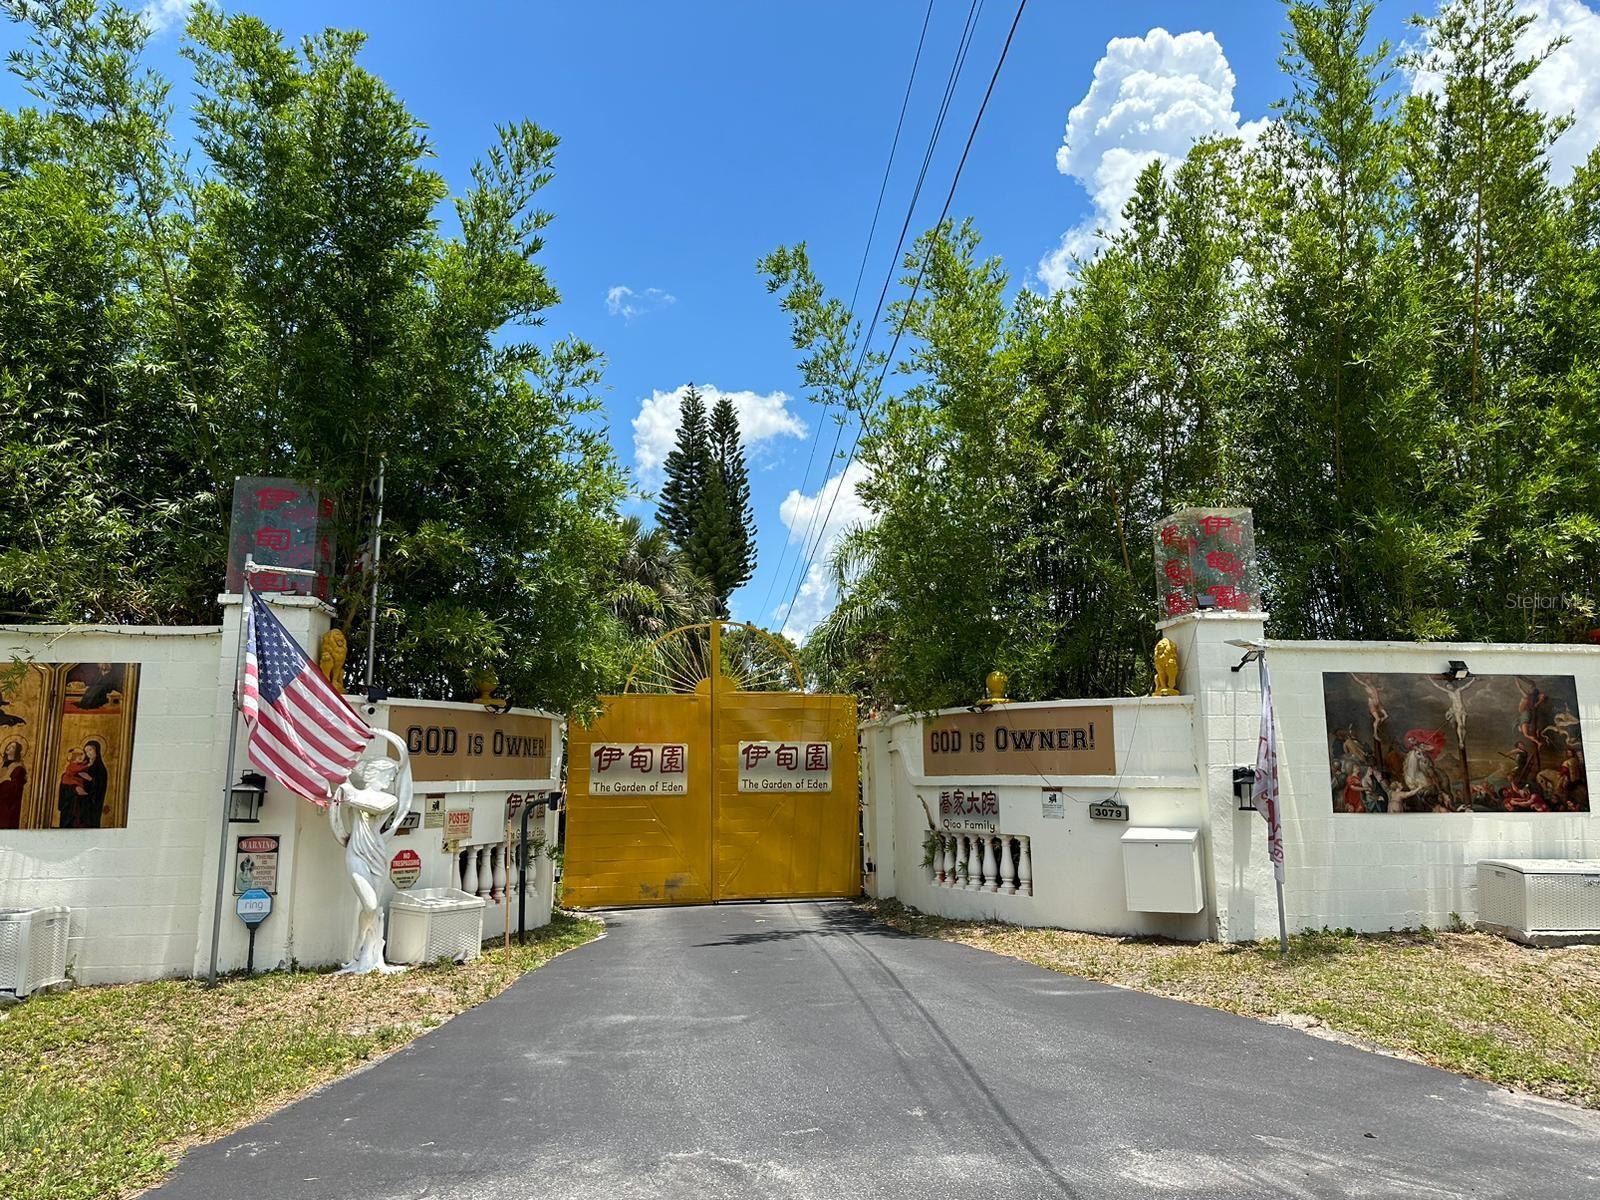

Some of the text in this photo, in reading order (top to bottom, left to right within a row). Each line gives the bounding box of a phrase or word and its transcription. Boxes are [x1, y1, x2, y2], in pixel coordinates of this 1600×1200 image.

[406, 725, 458, 755] GOD
[930, 729, 962, 754] GOD
[593, 745, 684, 773] 伊甸園
[741, 743, 829, 771] 伊甸園
[593, 781, 684, 792] The Garden of Eden
[742, 778, 828, 789] The Garden of Eden
[448, 812, 470, 824] POSTED
[1095, 808, 1122, 818] 3079
[943, 818, 996, 833] Qiao Family
[242, 841, 275, 849] WARNING
[244, 901, 264, 911] ring
